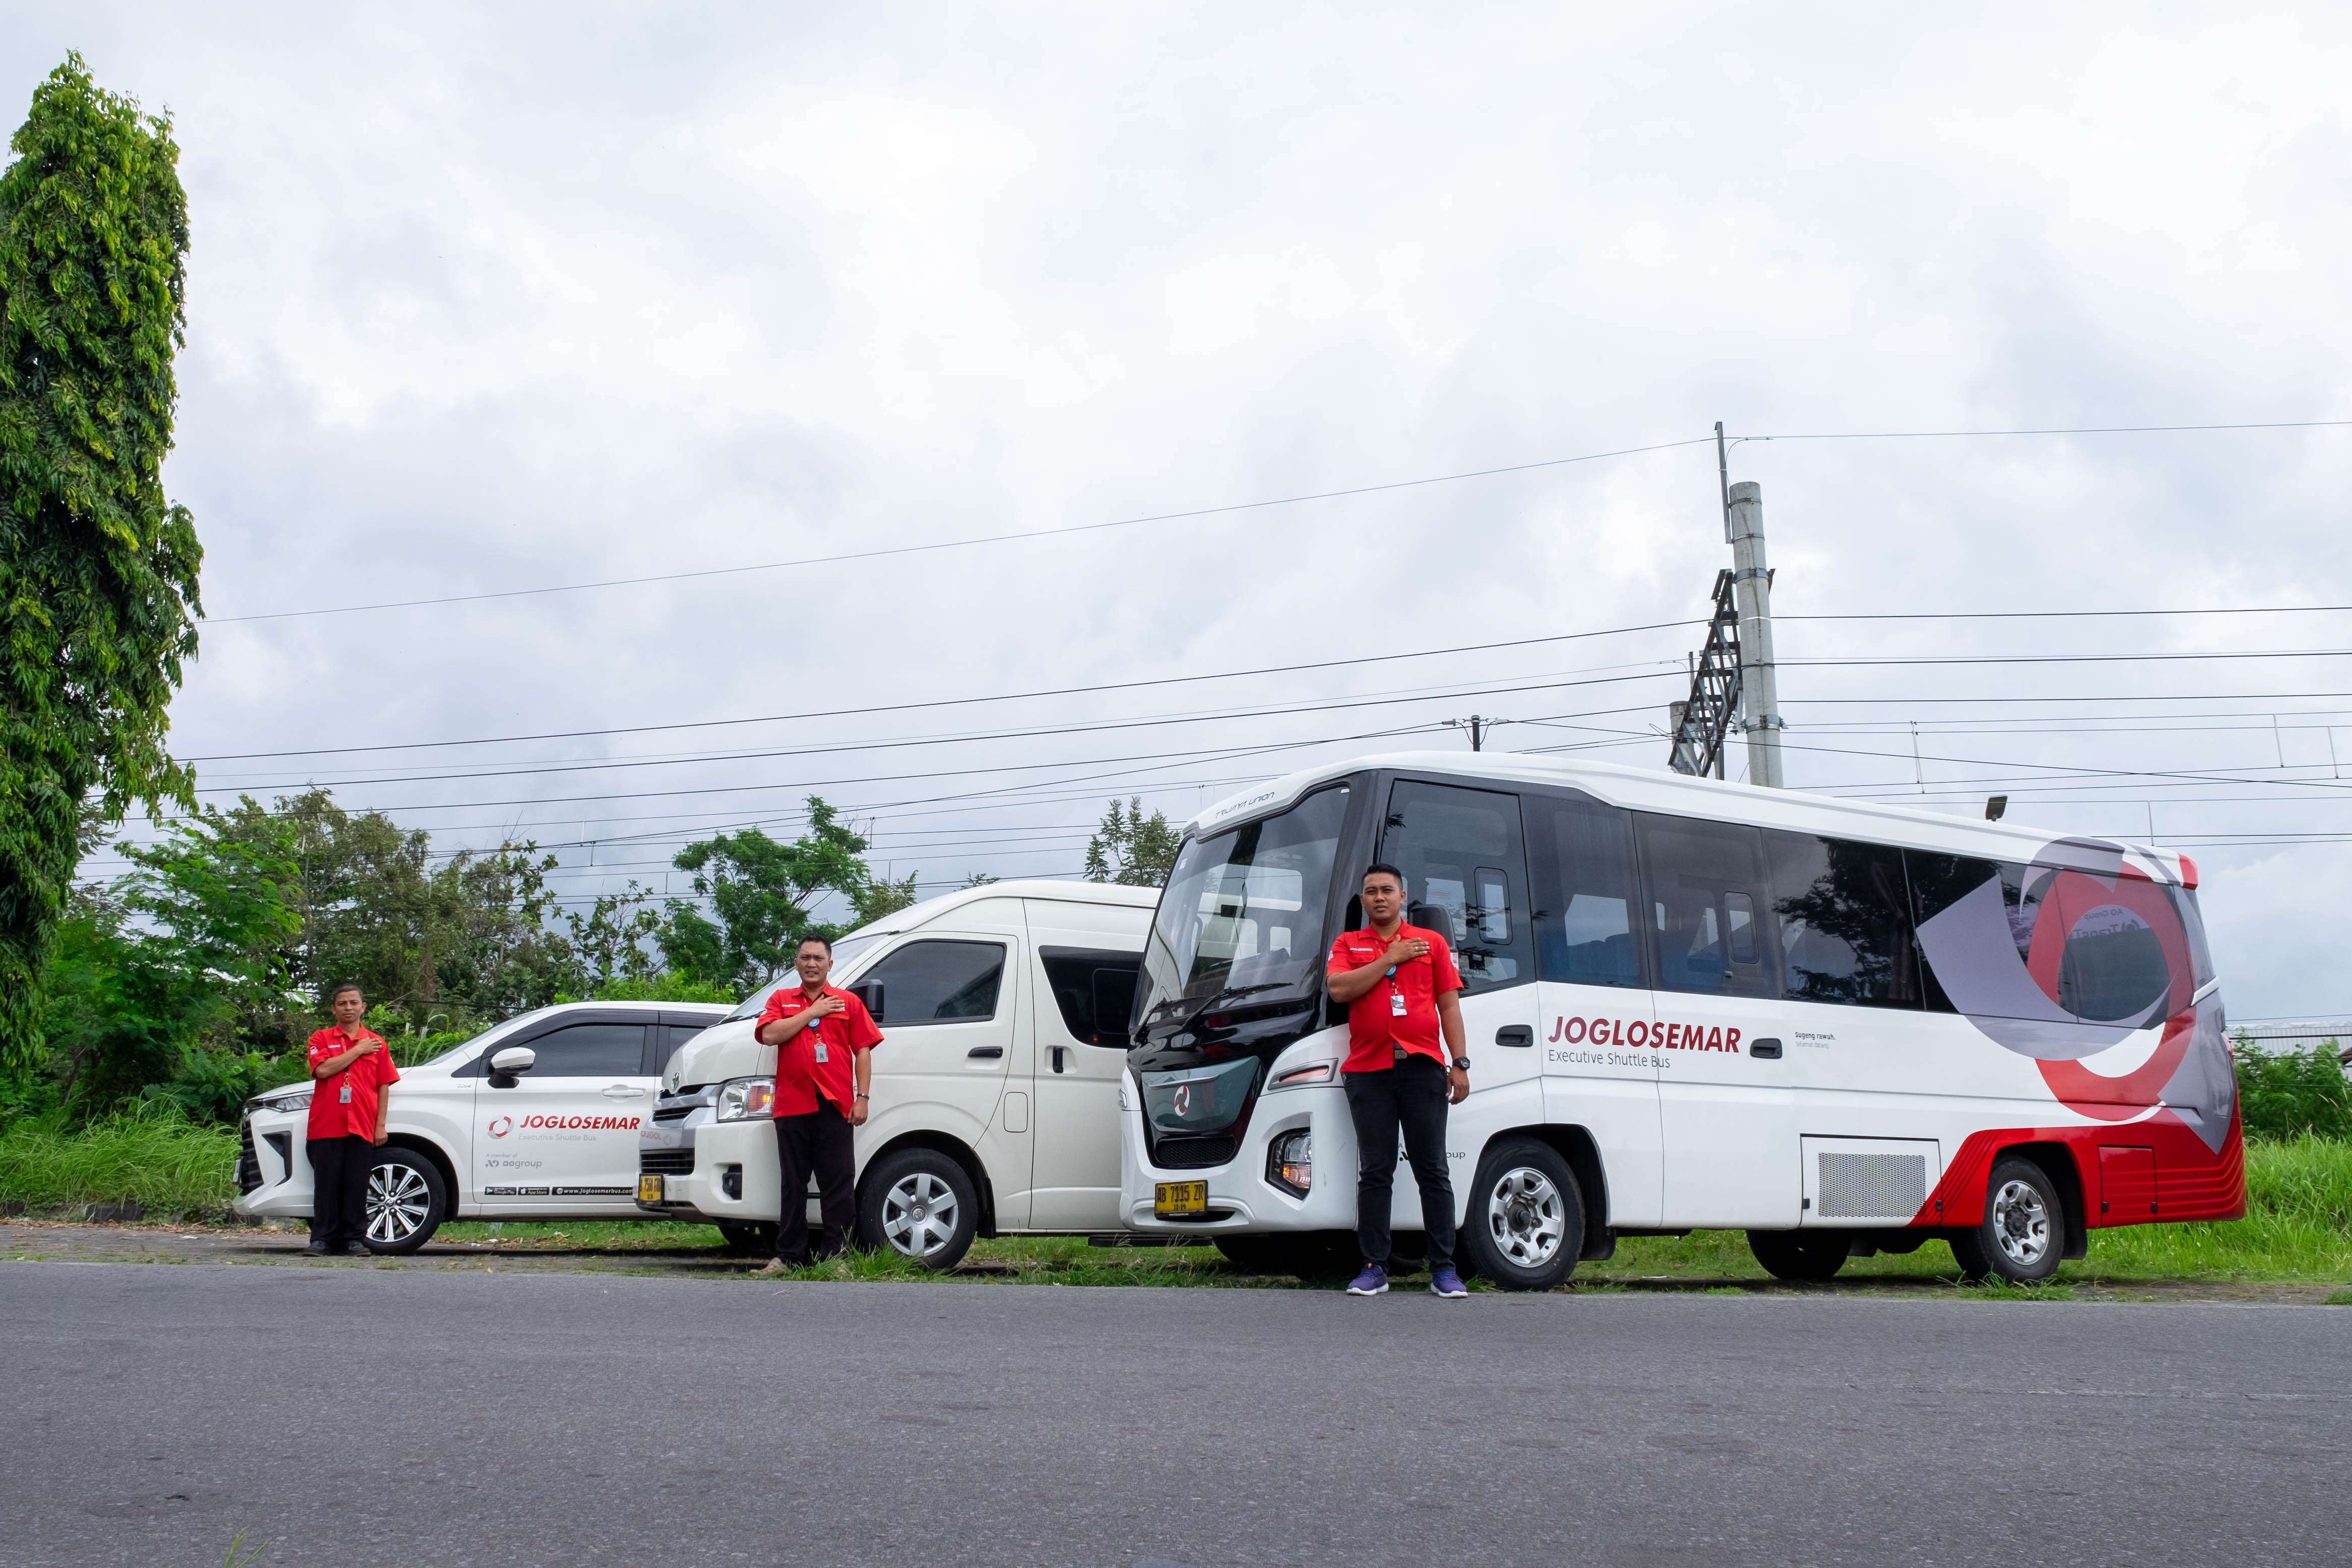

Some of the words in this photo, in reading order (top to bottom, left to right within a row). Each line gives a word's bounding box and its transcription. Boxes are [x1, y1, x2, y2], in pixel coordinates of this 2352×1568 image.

[1547, 1016, 1741, 1053] JOGLOSEMAR
[1548, 1049, 1604, 1064] Executive
[1608, 1053, 1648, 1067] Shuttle
[1651, 1056, 1670, 1068] Bus
[519, 1115, 640, 1130] JOGLOSEMAR
[503, 1161, 542, 1169] aogroup
[1157, 1187, 1167, 1202] AB
[1170, 1185, 1190, 1202] 7115
[1193, 1184, 1204, 1201] ZR
